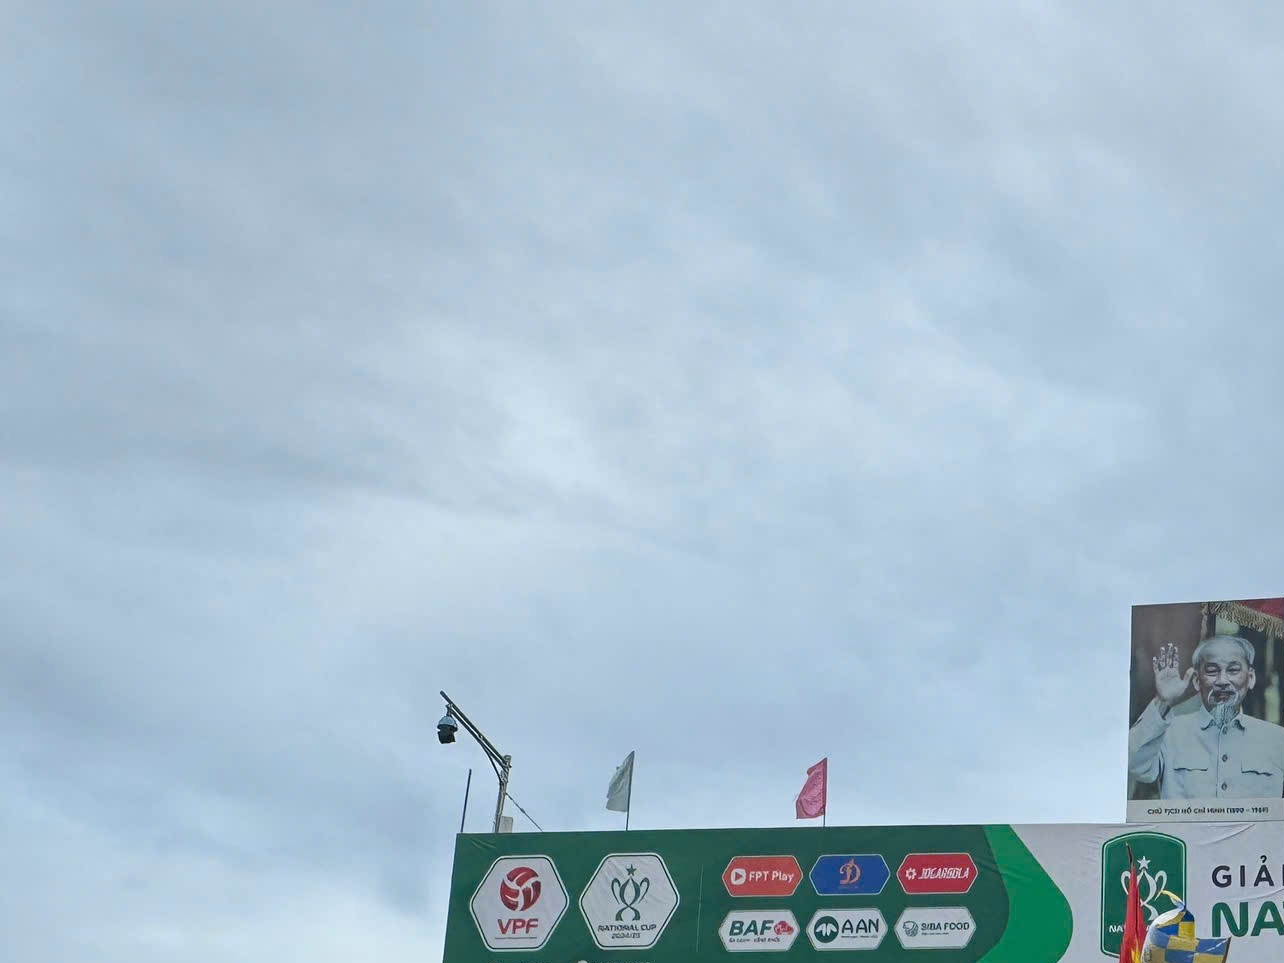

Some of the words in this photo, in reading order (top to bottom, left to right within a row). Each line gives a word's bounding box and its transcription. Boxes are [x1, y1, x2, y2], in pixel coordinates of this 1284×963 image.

[749, 872, 768, 882] FPT
[771, 871, 795, 883] Play
[497, 918, 539, 935] VPF
[597, 924, 639, 932] NATIONAL
[728, 920, 774, 937] BAF
[841, 918, 880, 934] AAN
[921, 922, 942, 931] SIBA
[944, 921, 970, 932] FOOD
